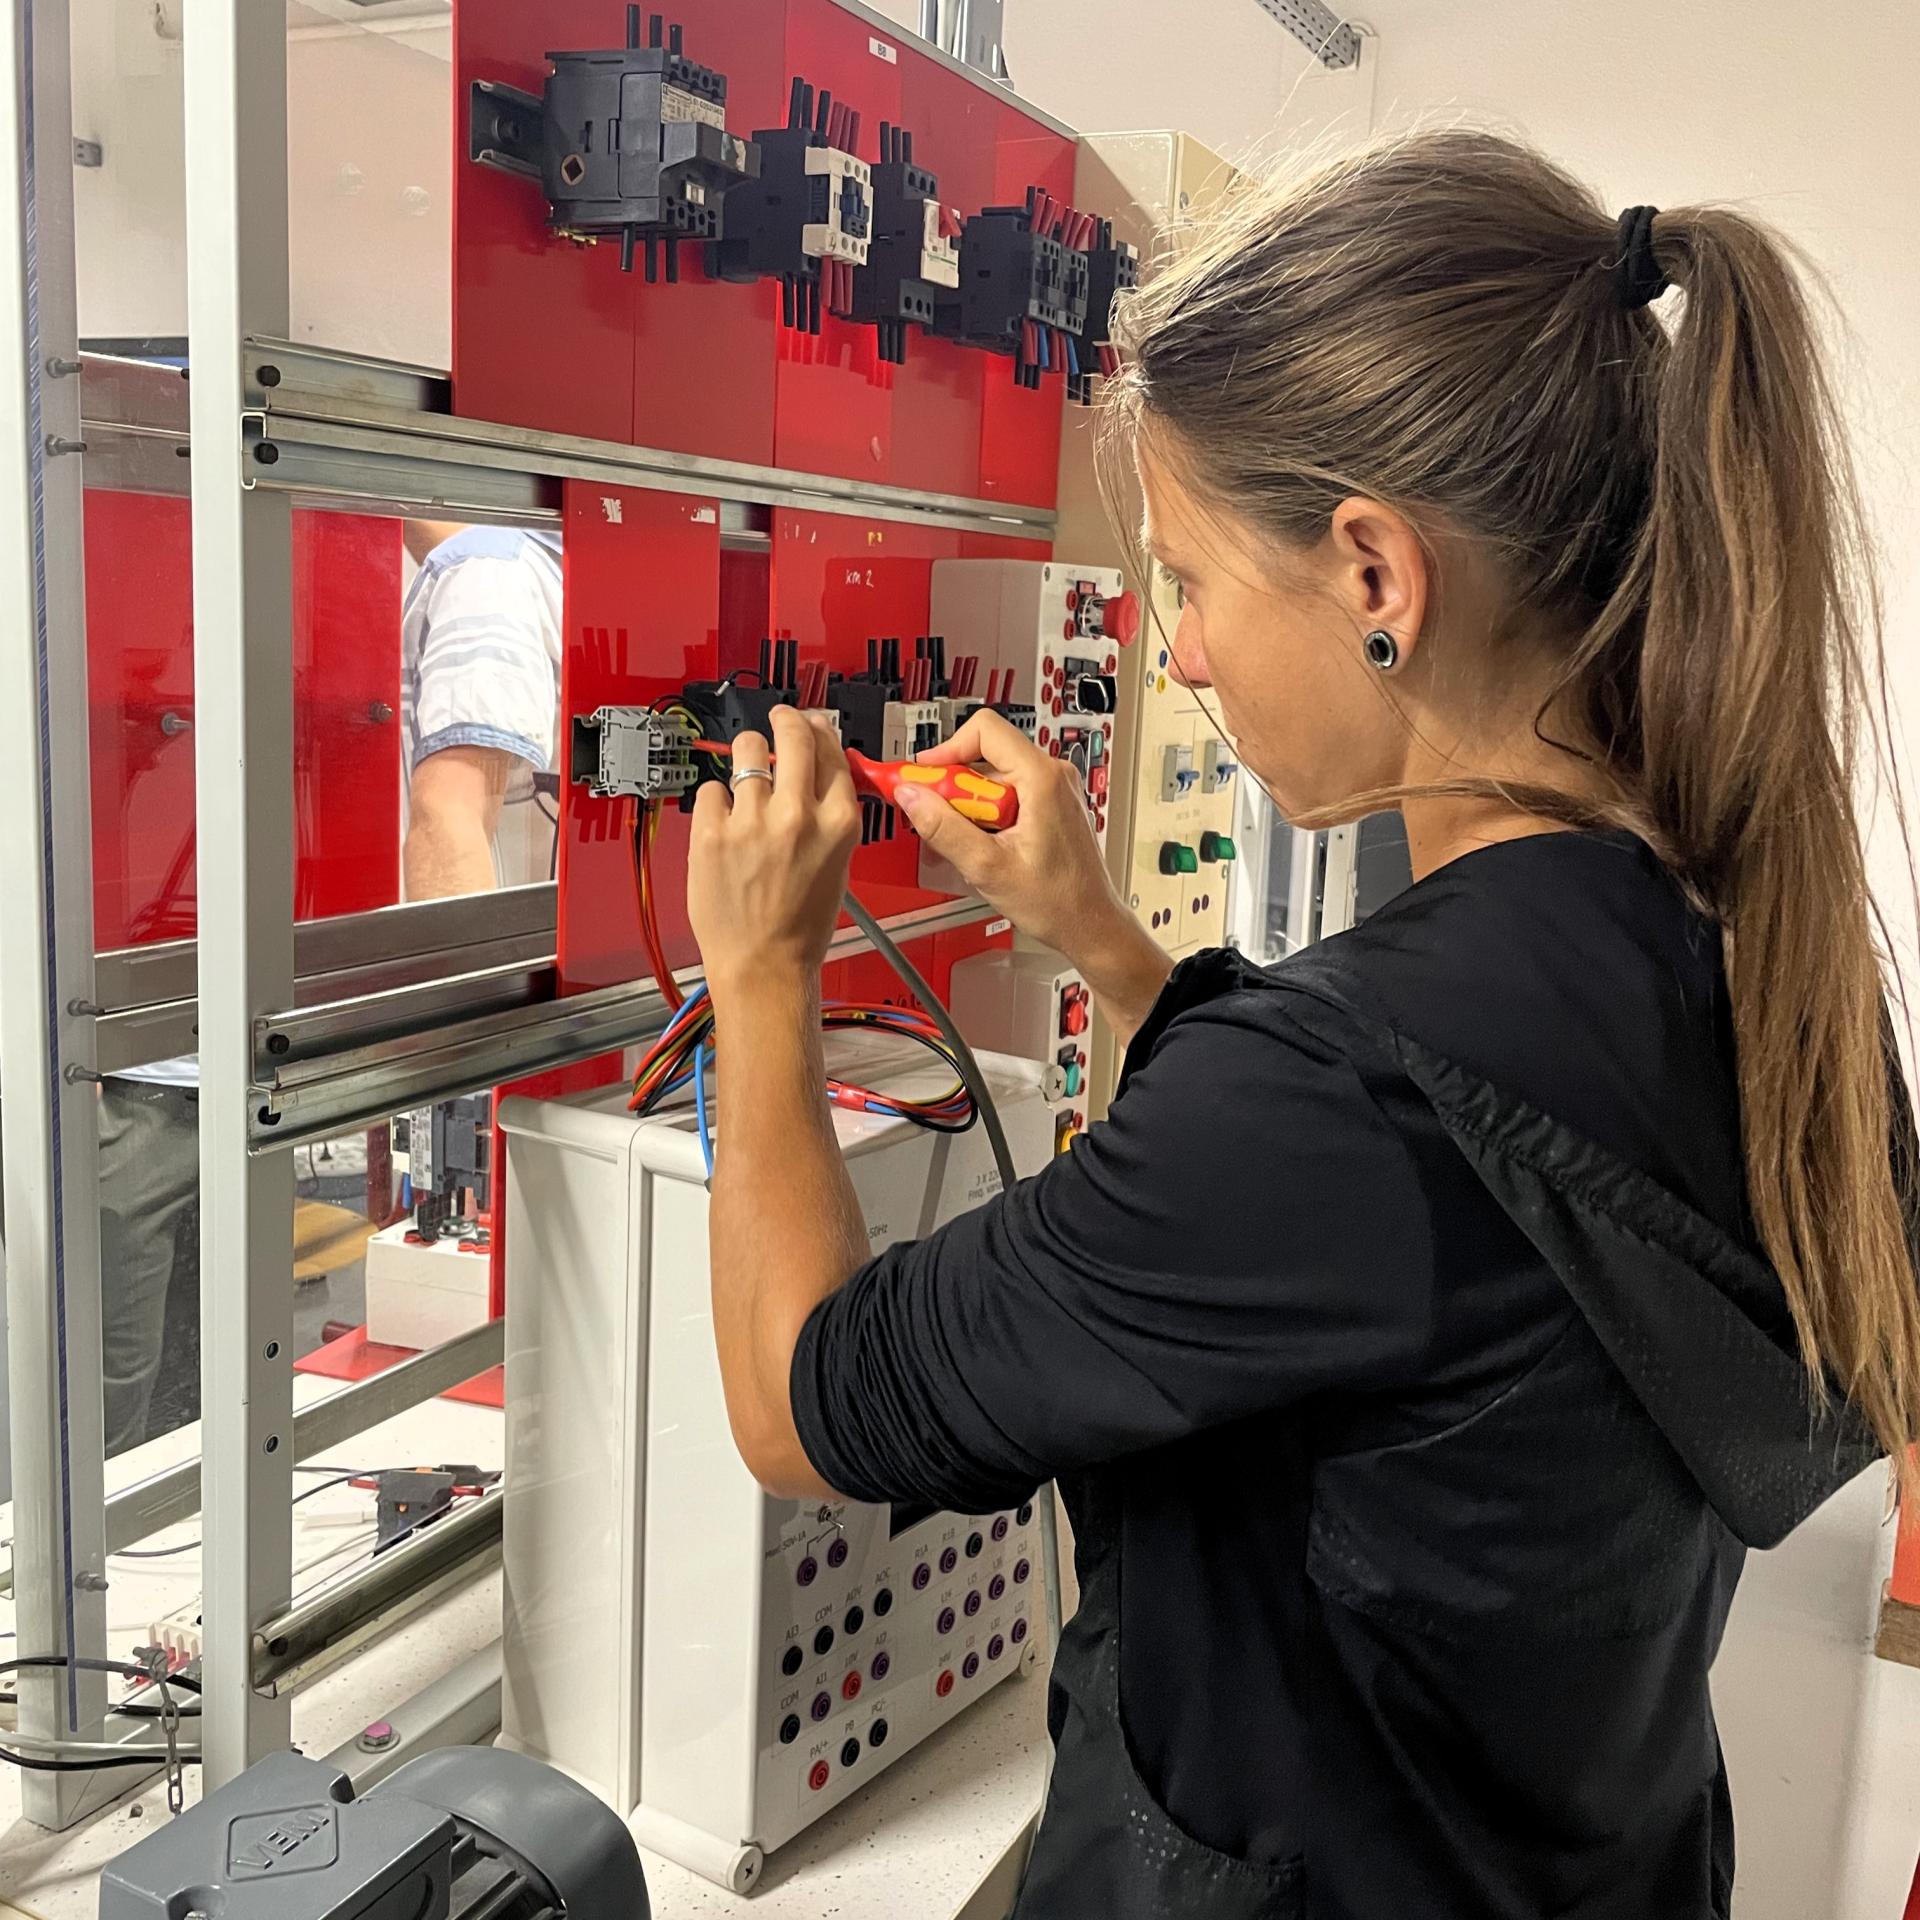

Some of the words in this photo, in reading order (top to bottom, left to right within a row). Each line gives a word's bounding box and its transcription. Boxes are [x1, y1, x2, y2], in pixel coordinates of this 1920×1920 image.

[815, 1603, 833, 1623] COM
[780, 1690, 800, 1710] COM
[231, 1809, 330, 1870] VEM
